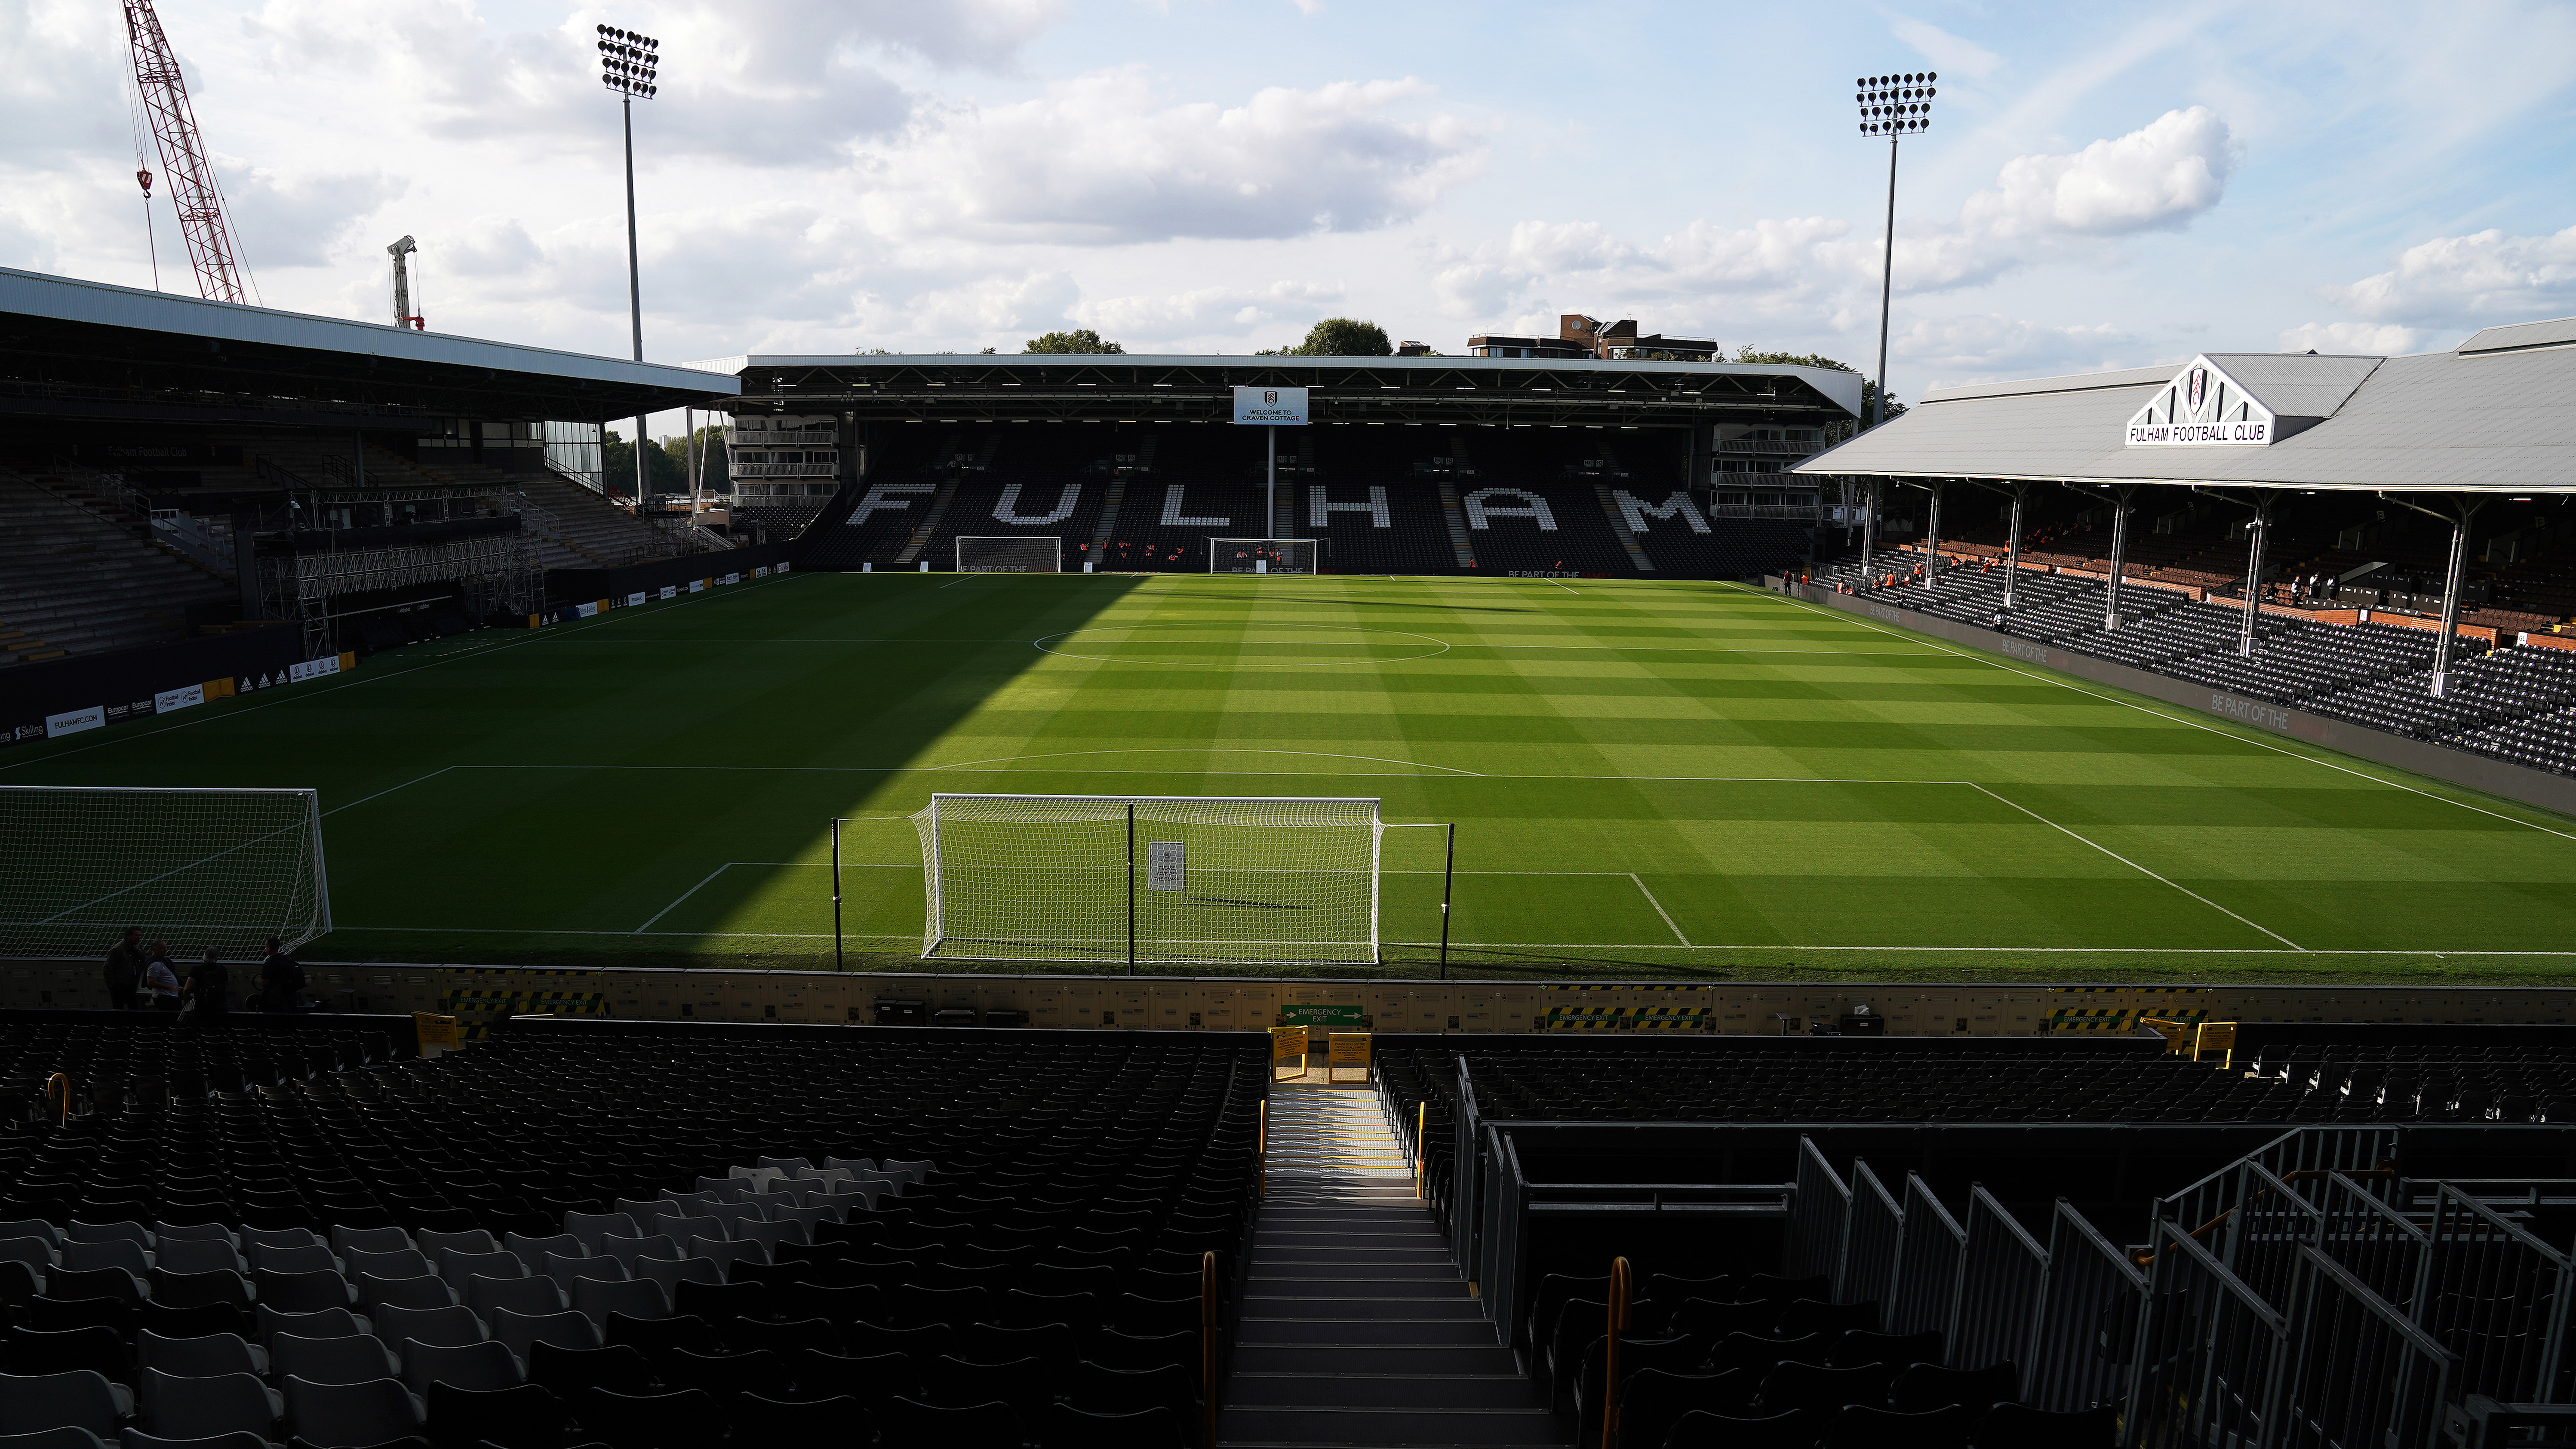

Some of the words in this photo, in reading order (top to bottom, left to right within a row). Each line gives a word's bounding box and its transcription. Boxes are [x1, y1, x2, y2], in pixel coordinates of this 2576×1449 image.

[2130, 427, 2169, 442] FULHAM
[2173, 426, 2228, 442] FOOTBALL
[2235, 424, 2265, 440] CLUB
[138, 446, 169, 457] Football
[171, 446, 187, 457] Club
[846, 483, 1712, 534] FULHAM
[1870, 604, 1875, 615] BE
[1875, 606, 1886, 619] PART
[1886, 608, 1892, 620] OF
[2002, 639, 2010, 653] BE
[2010, 641, 2026, 656] PART
[2026, 644, 2034, 658] OF
[2035, 647, 2047, 663] THE
[108, 704, 129, 714] Europcar
[132, 700, 153, 709] Europcar
[2212, 694, 2224, 712] BE
[2225, 697, 2250, 719] PART
[2251, 705, 2266, 723] OF
[2268, 708, 2289, 730] THE
[55, 714, 98, 729] FULHAMFC.COM
[22, 725, 43, 735] Skilling
